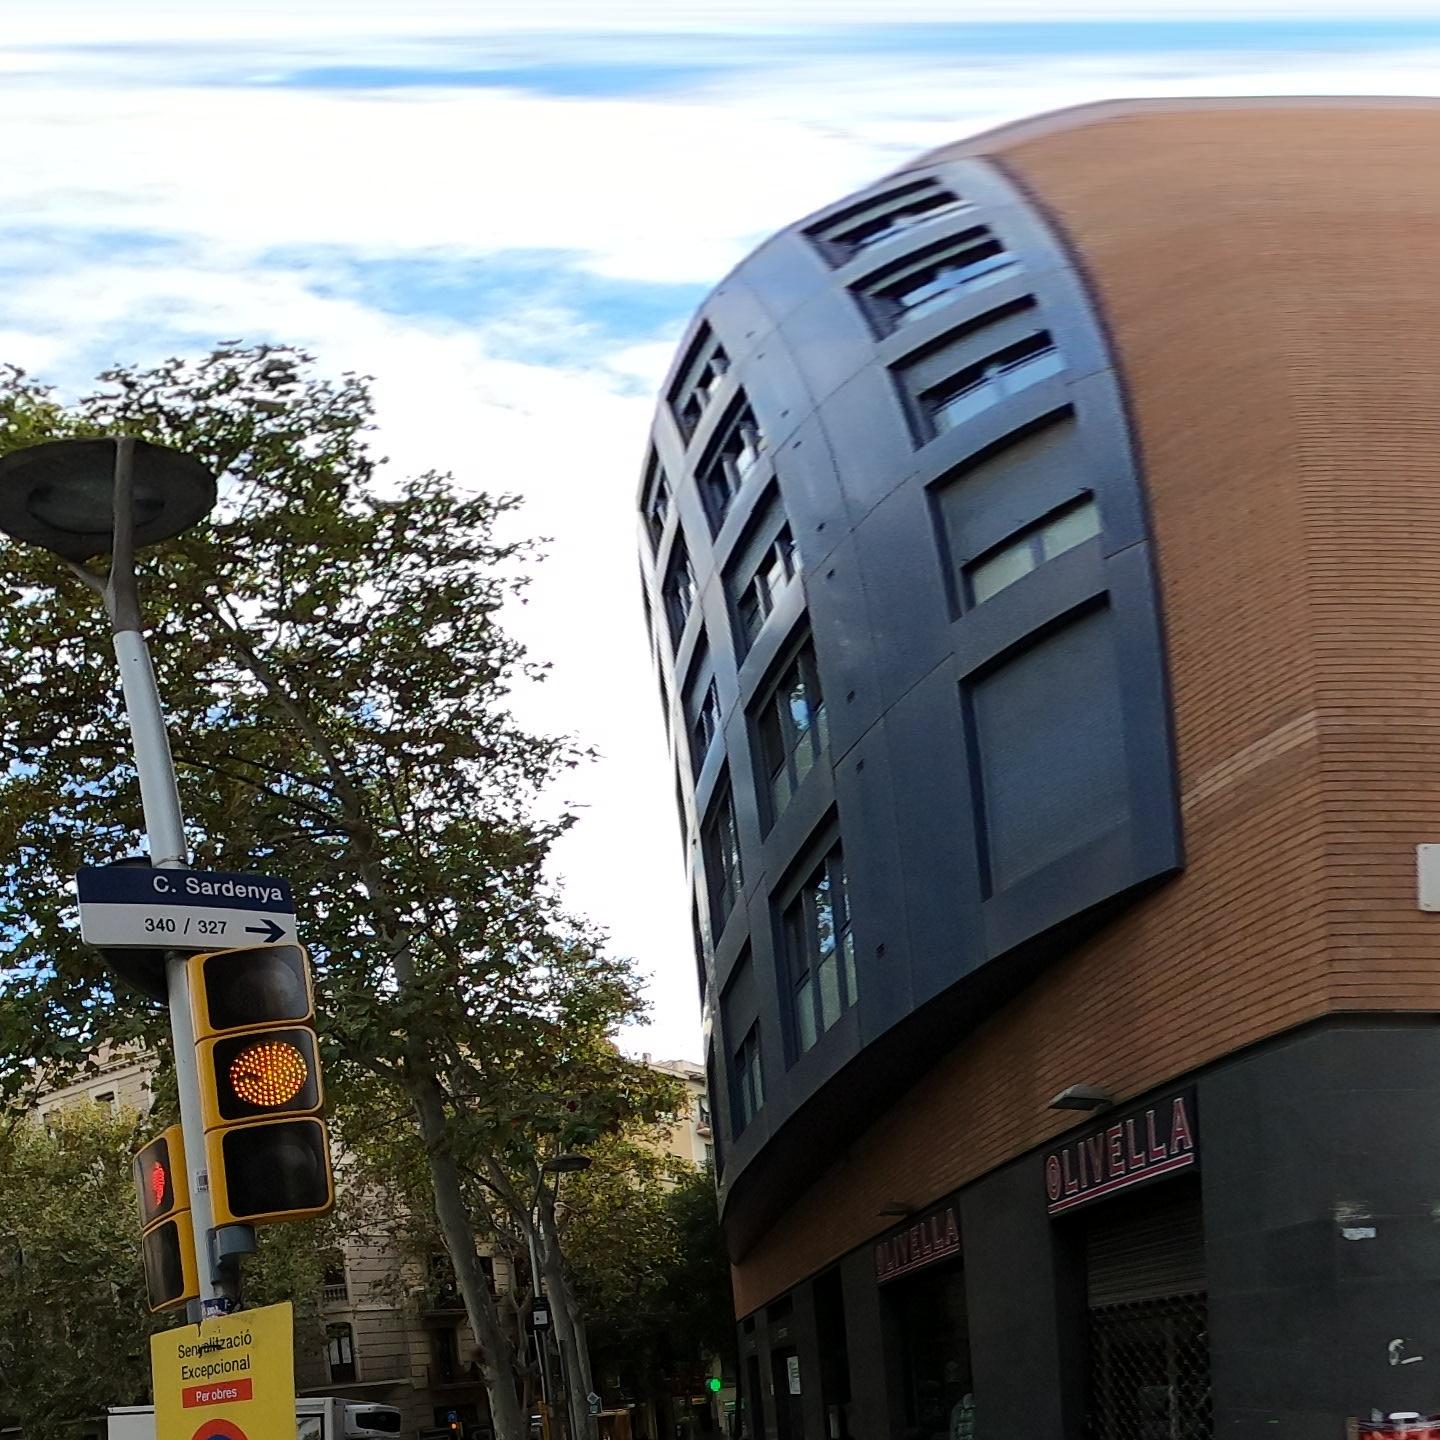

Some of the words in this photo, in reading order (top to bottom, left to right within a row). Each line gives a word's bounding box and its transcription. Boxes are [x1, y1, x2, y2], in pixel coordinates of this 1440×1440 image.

[153, 876, 177, 893] C.
[186, 877, 284, 904] Sardenya
[144, 918, 176, 933] 340
[183, 917, 191, 935] /
[197, 920, 227, 935] 327
[1045, 1096, 1193, 1201] OLIVELLA
[874, 1207, 959, 1275] OLIVELLA
[177, 1328, 253, 1359] Senyalització
[181, 1354, 251, 1381] Excepcional
[195, 1390, 210, 1402] Per
[212, 1387, 238, 1401] obres
